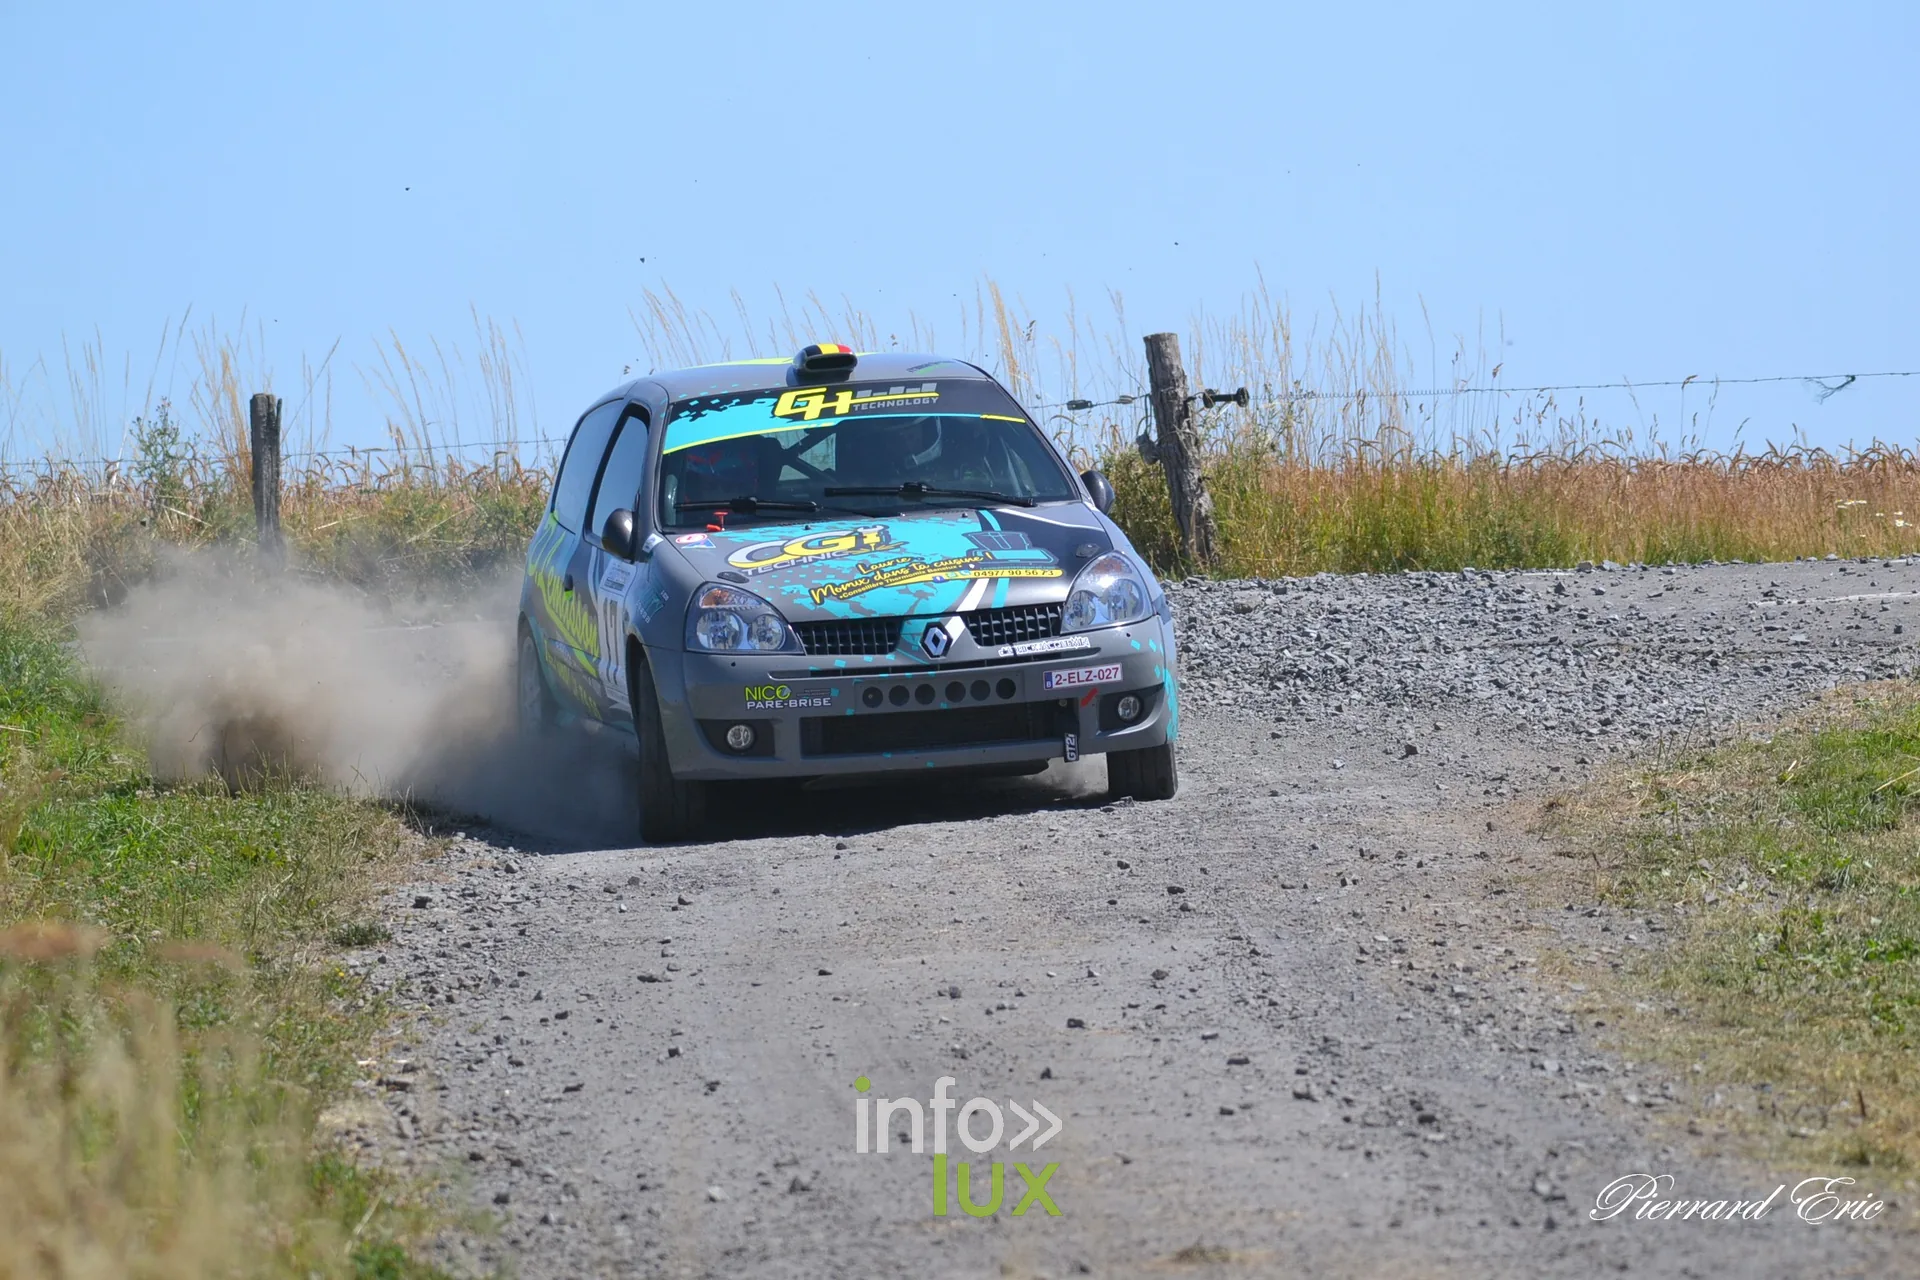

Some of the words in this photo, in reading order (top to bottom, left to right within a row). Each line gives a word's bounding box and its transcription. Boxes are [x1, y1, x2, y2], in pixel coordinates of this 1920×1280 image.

[853, 396, 940, 412] TECHNOLOGY
[873, 566, 910, 581] dans
[911, 562, 931, 571] ta
[934, 555, 984, 568] cuisine
[886, 570, 927, 584] Thermomix
[1054, 667, 1120, 686] 2-ELZ-027
[745, 685, 791, 701] NICO
[746, 697, 832, 710] PARE-BRISE
